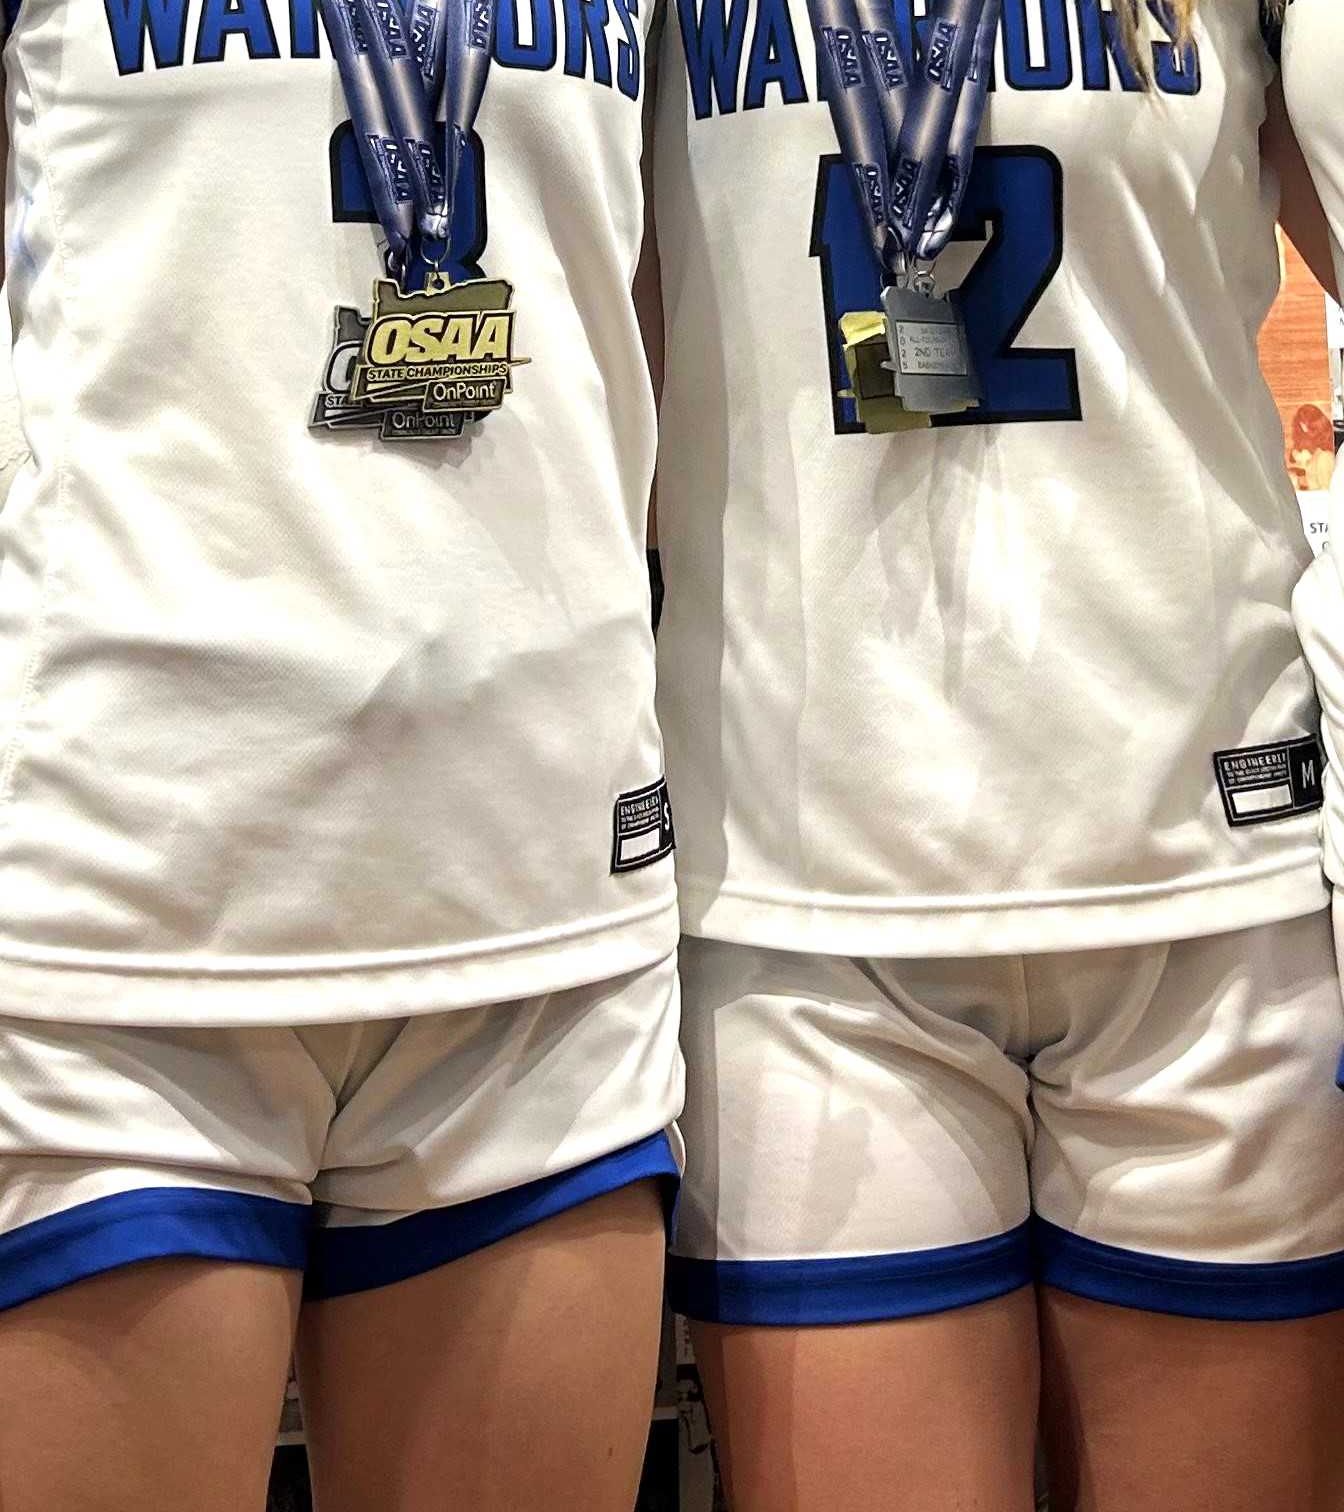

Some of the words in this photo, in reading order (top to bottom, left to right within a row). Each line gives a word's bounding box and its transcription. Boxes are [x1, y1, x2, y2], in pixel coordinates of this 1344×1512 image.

[369, 312, 514, 366] OSAA
[367, 366, 404, 381] STATE
[406, 362, 508, 380] CHAMPIONSHIPS
[433, 381, 498, 402] OnPoint
[1301, 759, 1316, 789] M
